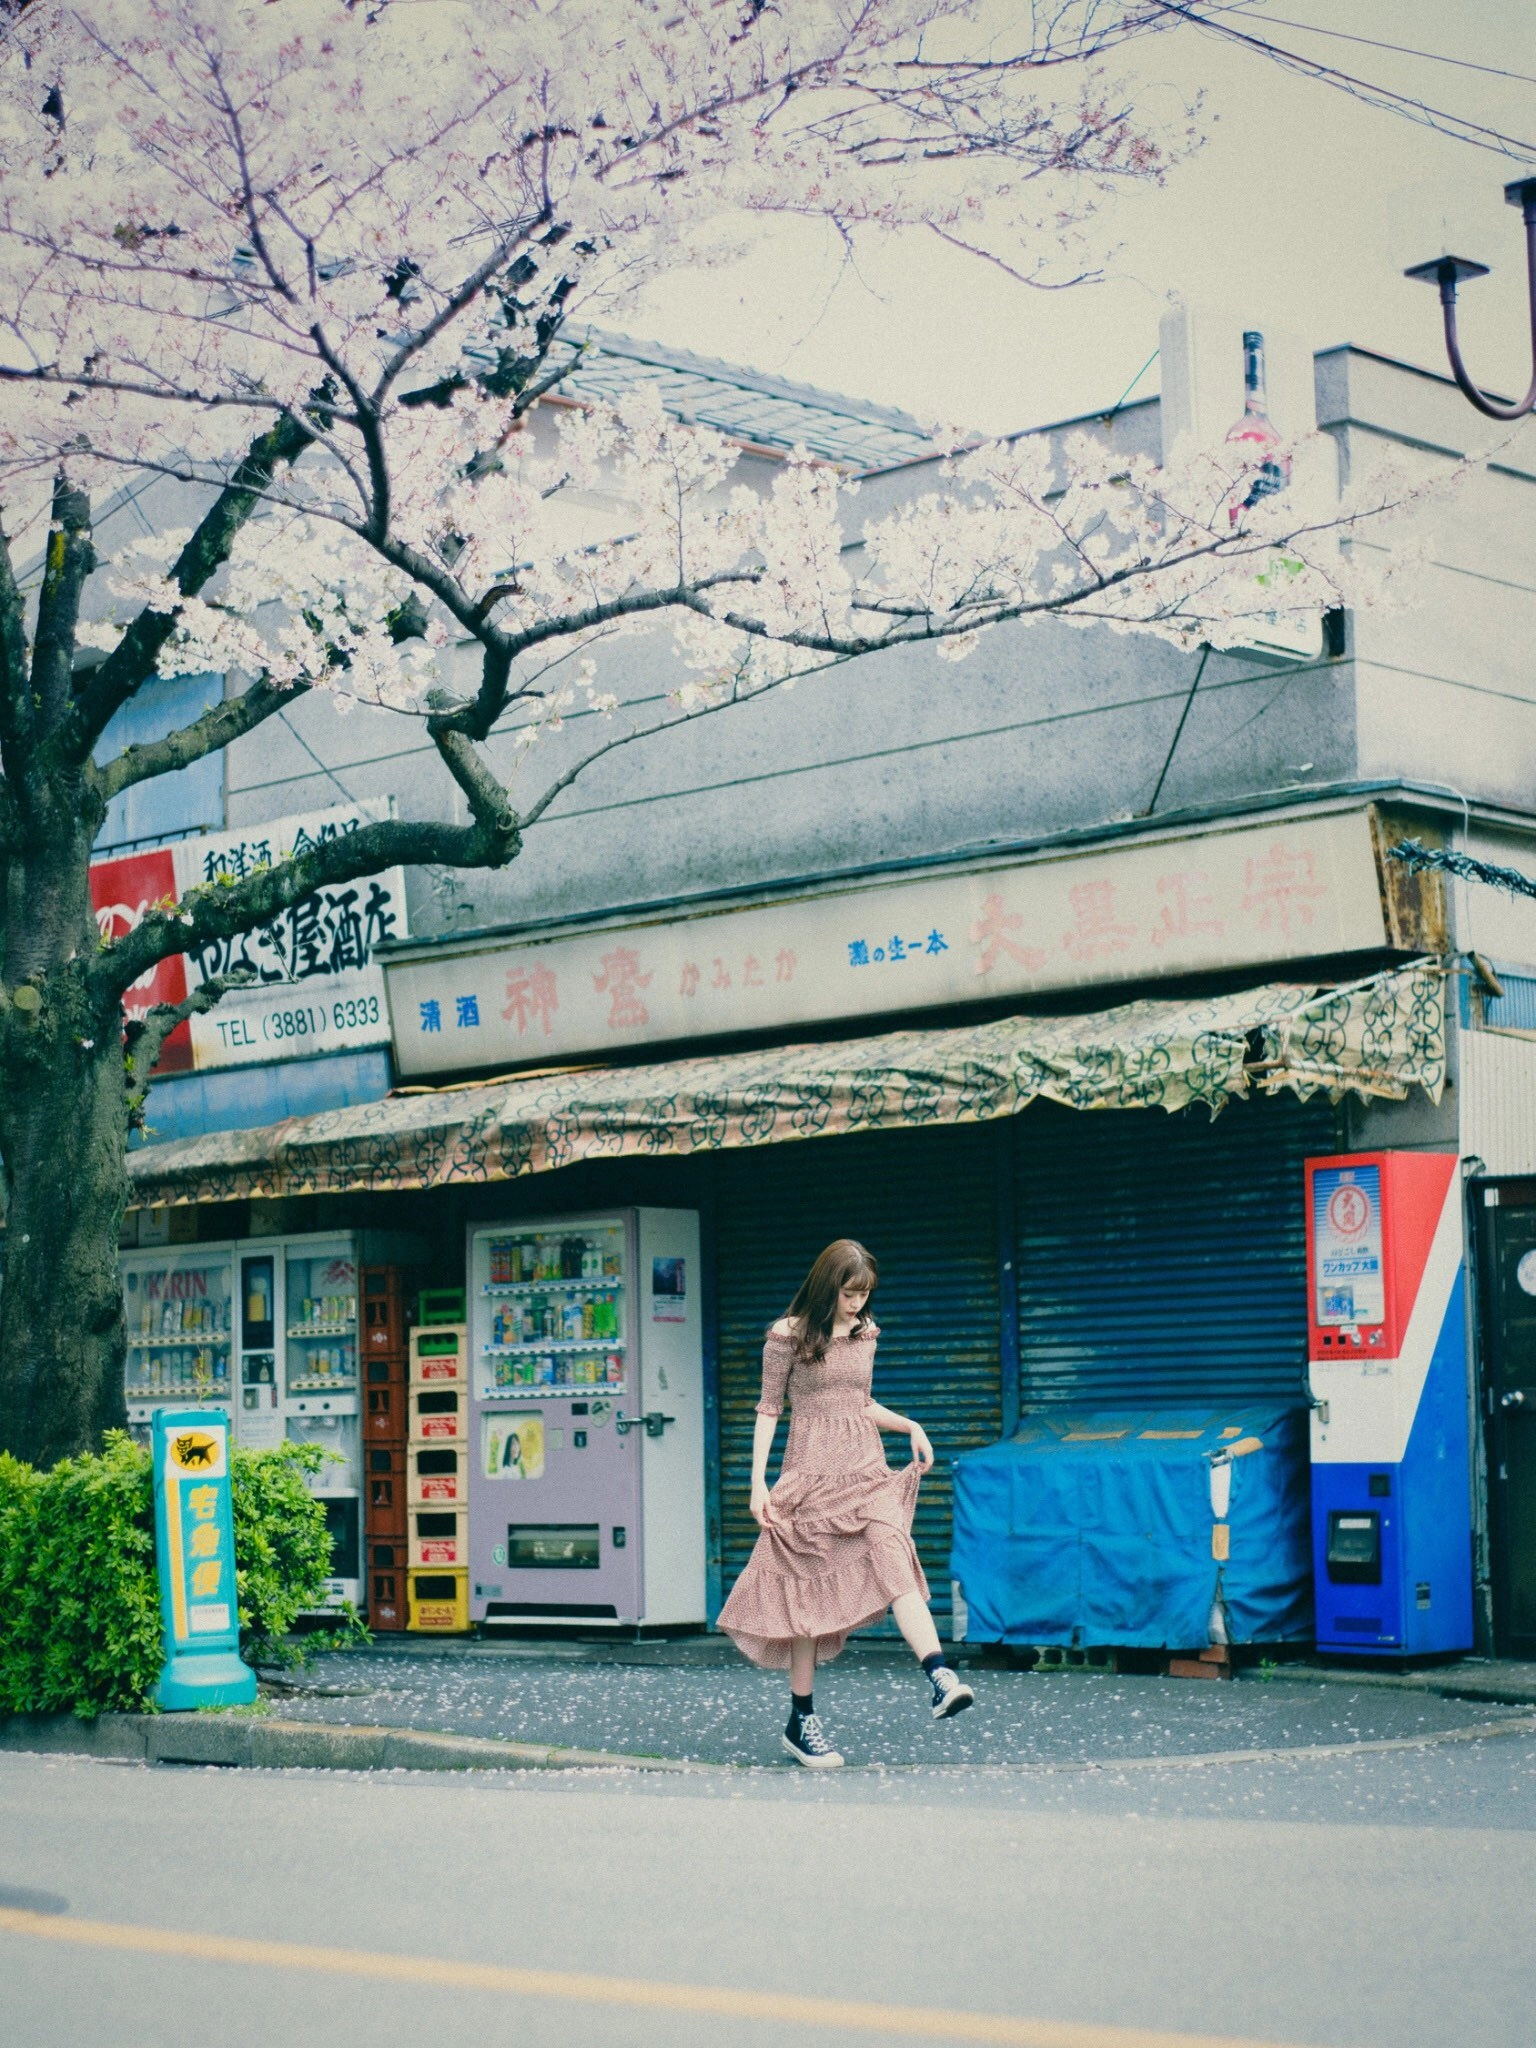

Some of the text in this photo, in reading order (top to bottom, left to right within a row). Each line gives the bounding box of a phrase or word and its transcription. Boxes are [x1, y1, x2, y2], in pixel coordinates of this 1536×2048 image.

[847, 929, 949, 967] 灘の生一本
[420, 994, 480, 1033] 清酒
[679, 947, 797, 997] かみたか
[217, 996, 380, 1048] TEL (3881) 6333
[149, 1269, 207, 1299] KIRIN
[188, 1484, 222, 1597] 宅急便
